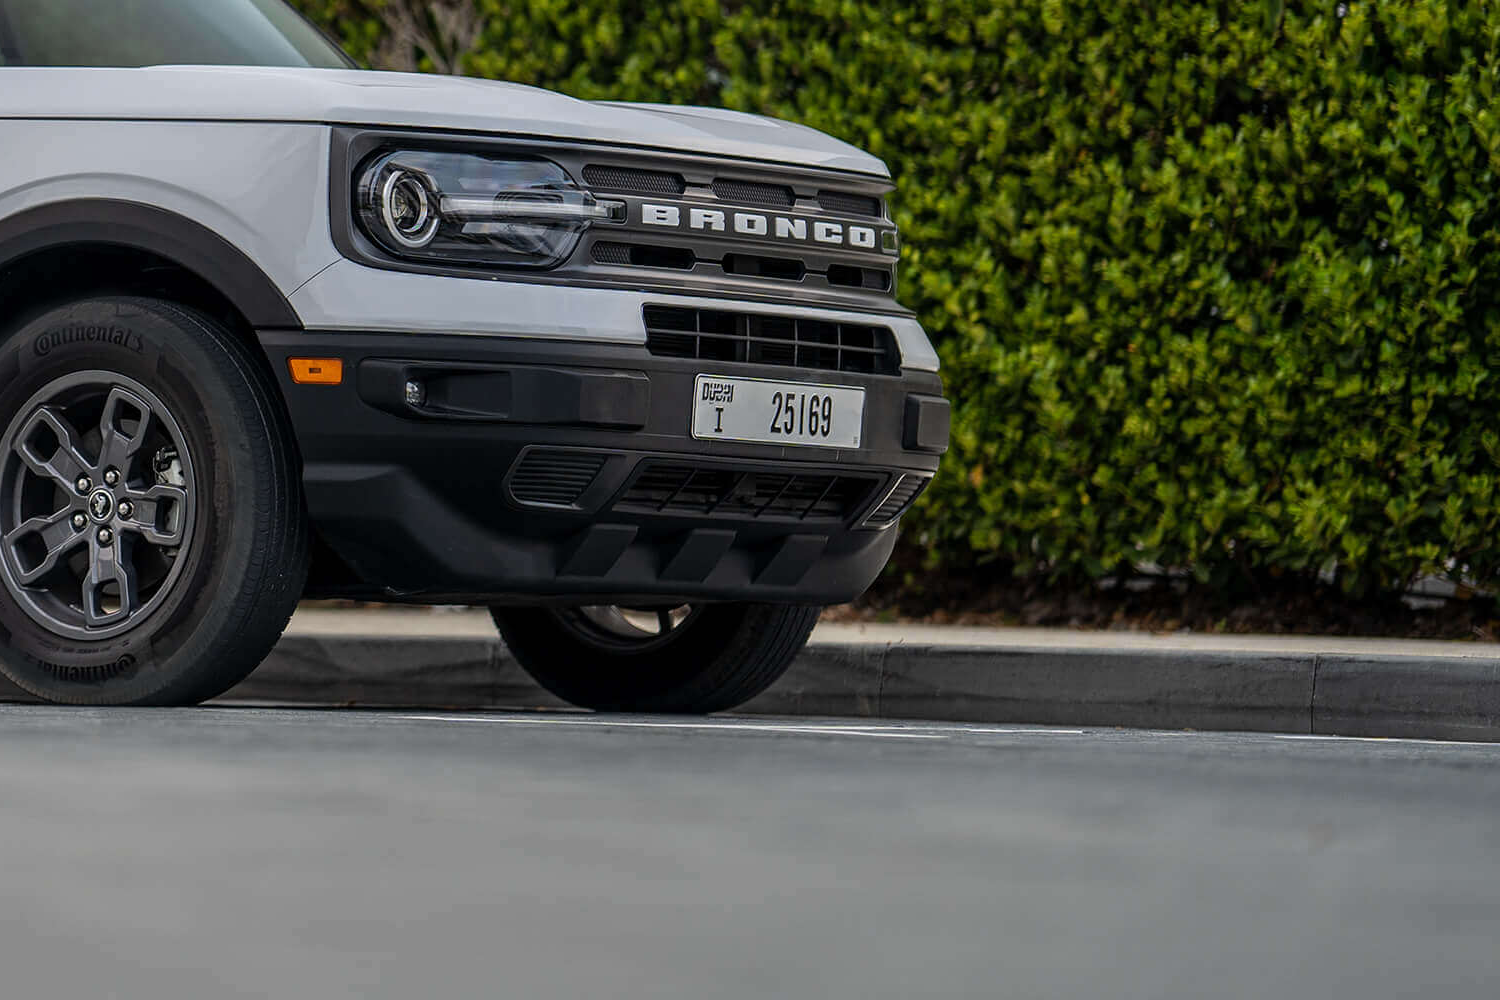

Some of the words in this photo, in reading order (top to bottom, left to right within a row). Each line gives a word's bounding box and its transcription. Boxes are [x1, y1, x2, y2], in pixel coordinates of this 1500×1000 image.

[641, 203, 876, 249] BRONCO
[33, 326, 133, 356] Continental
[770, 391, 833, 438] 25169
